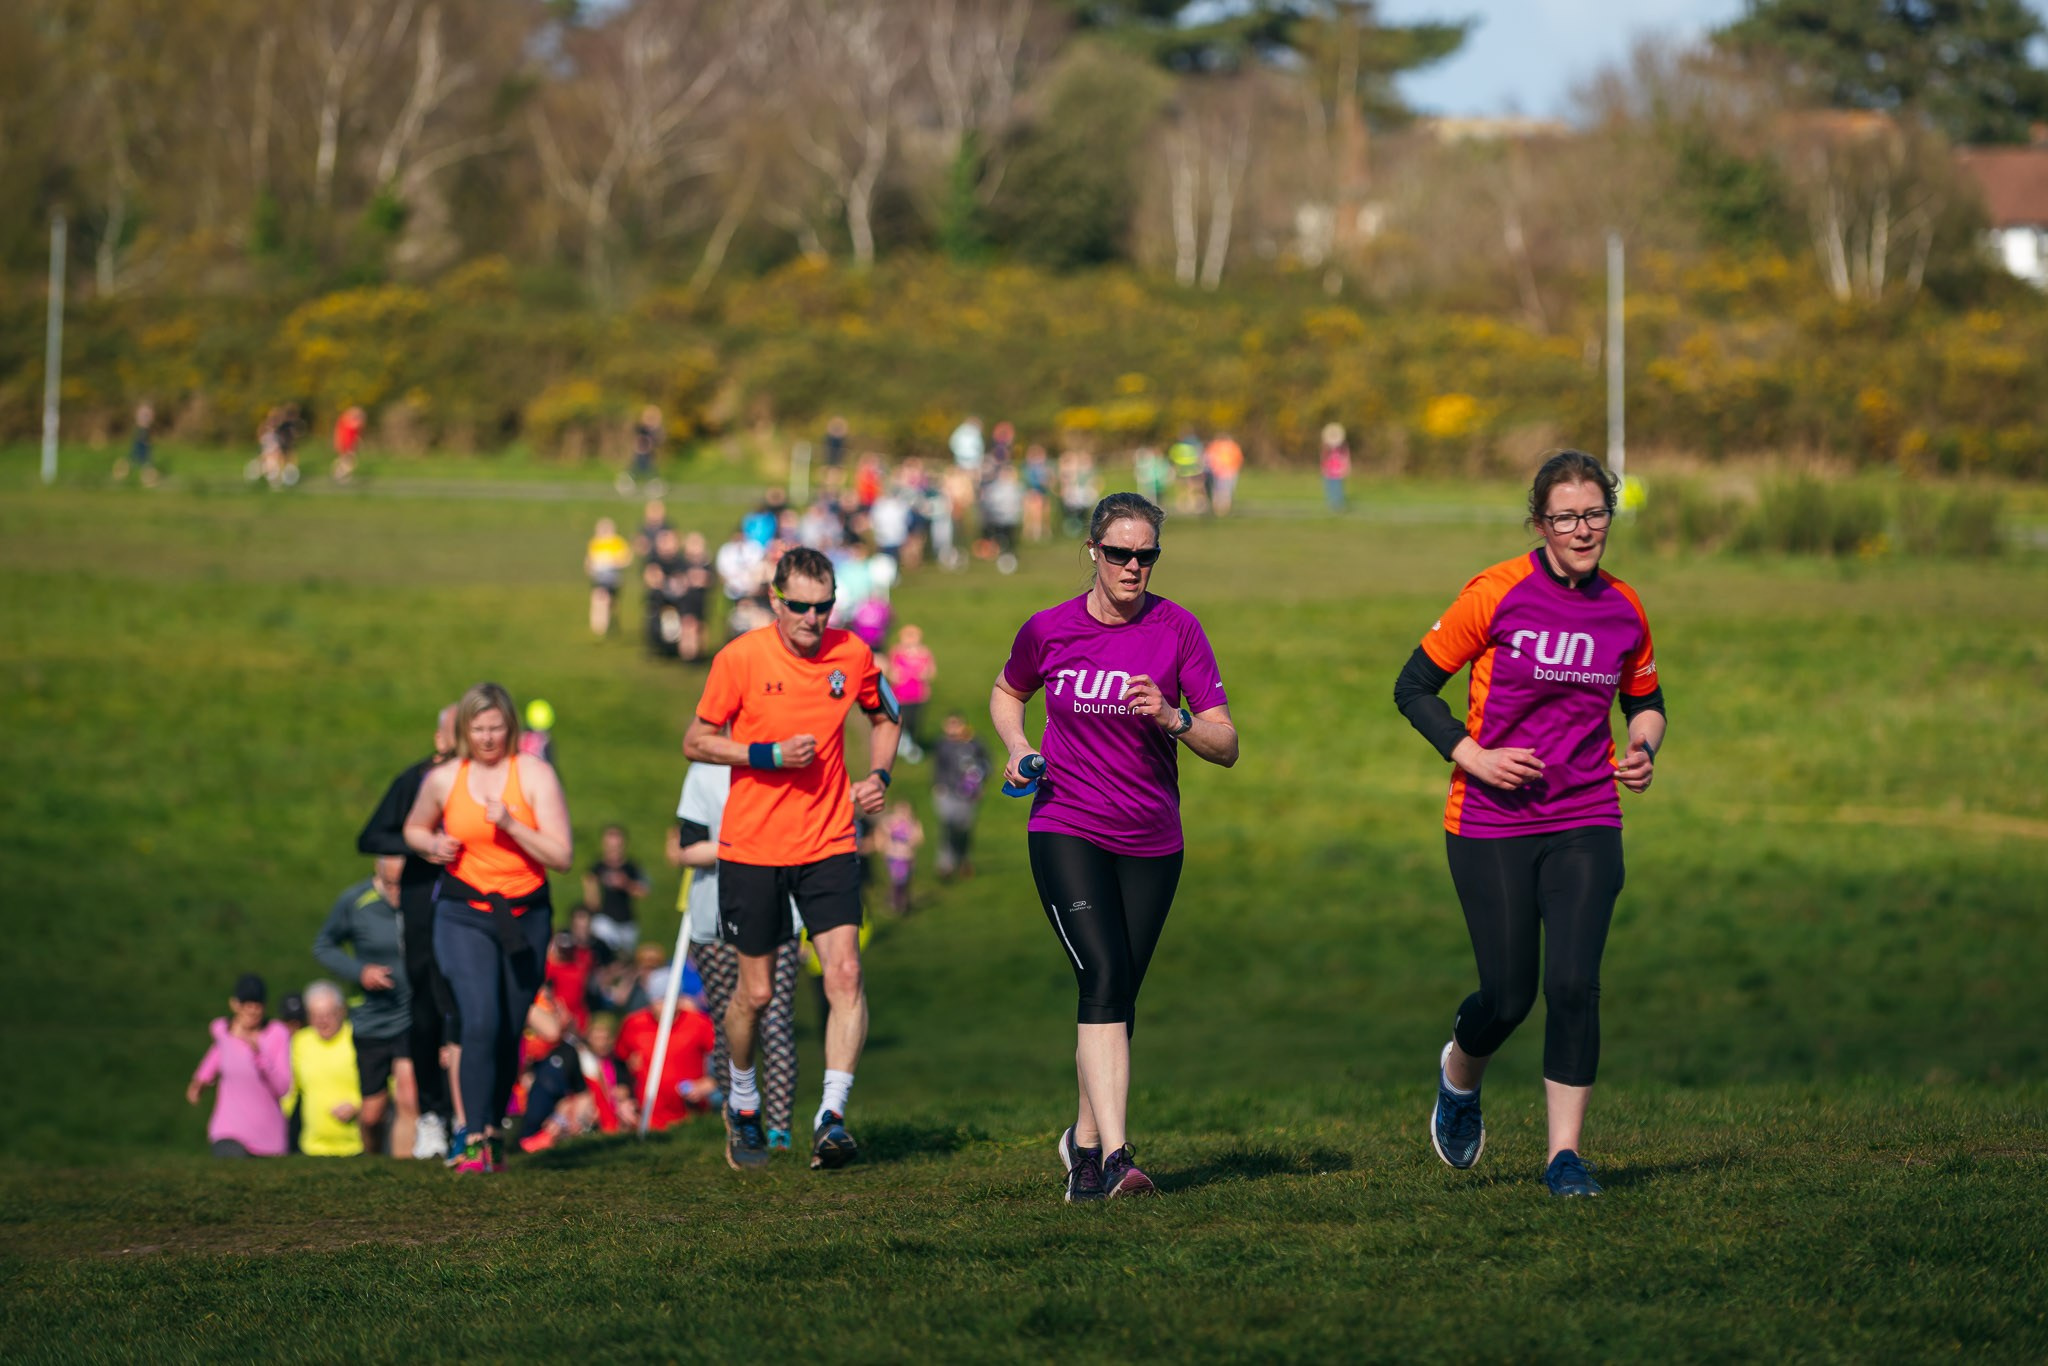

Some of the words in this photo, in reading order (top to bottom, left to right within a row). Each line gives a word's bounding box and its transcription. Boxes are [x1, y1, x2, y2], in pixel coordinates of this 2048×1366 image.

[1508, 629, 1595, 667] run
[1054, 669, 1131, 701] run
[1533, 665, 1621, 685] bournemou
